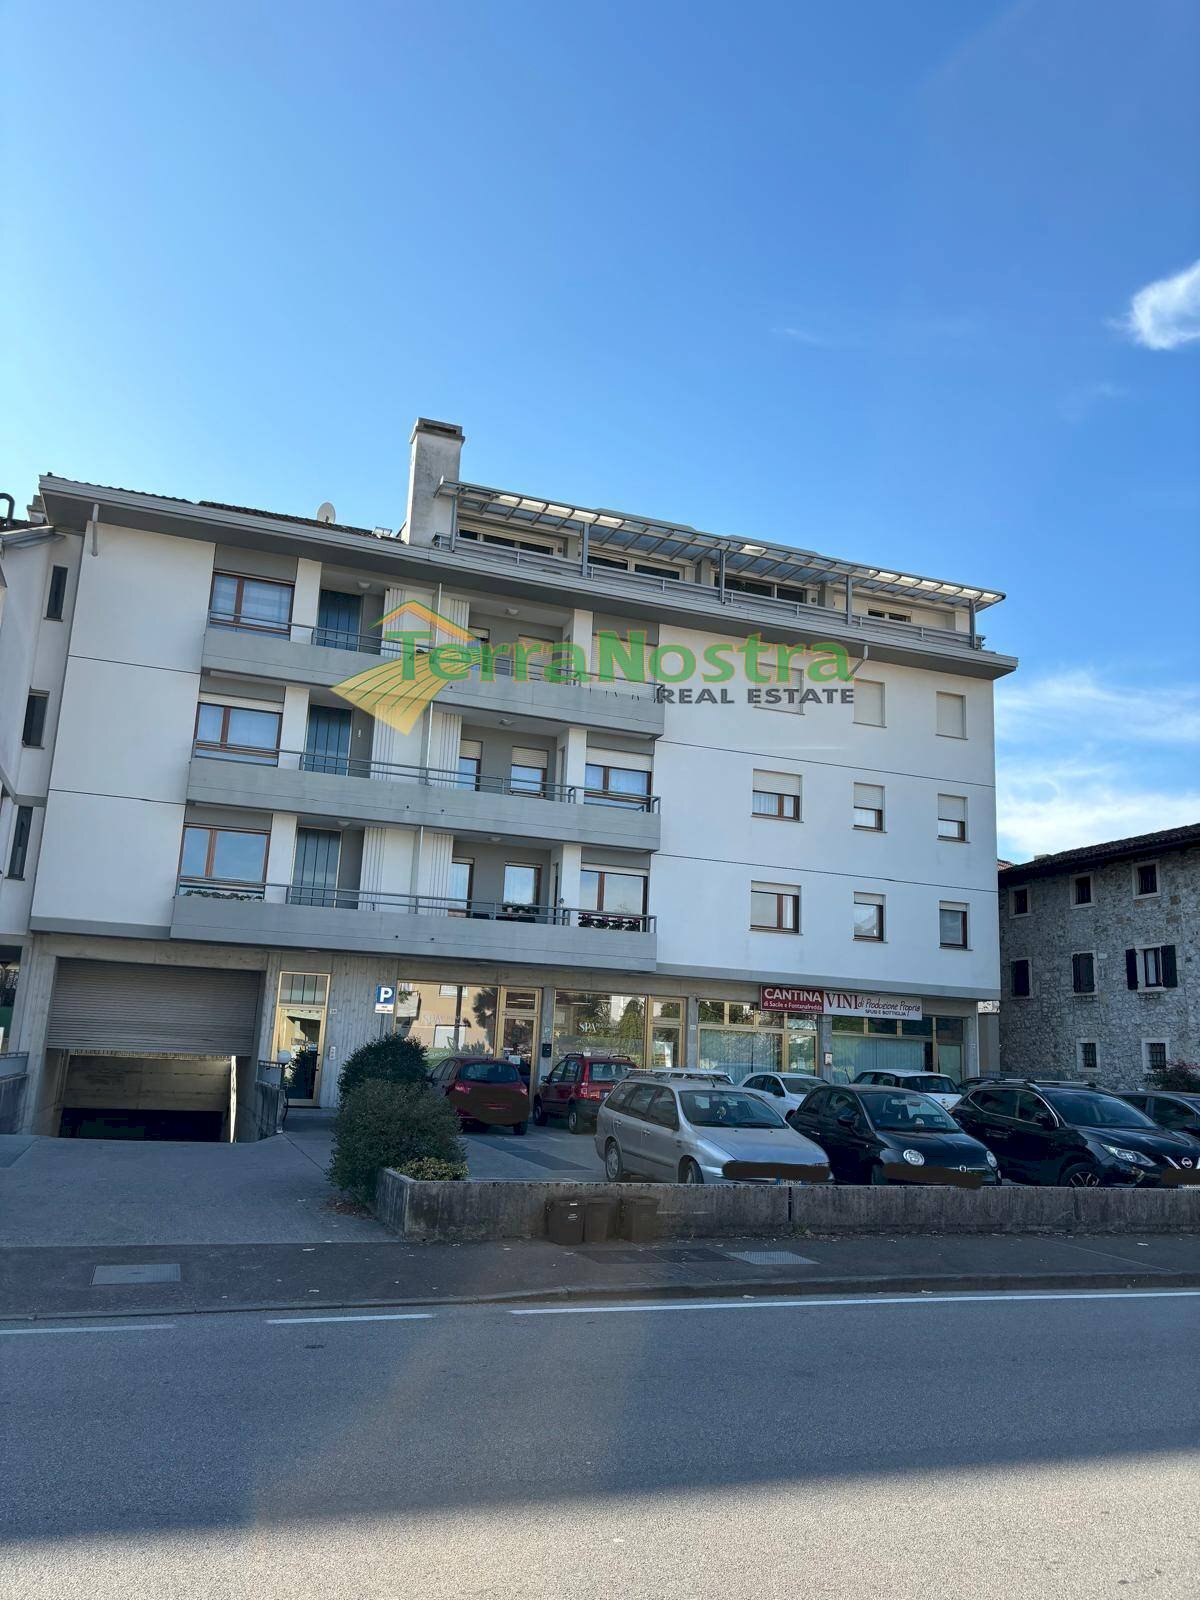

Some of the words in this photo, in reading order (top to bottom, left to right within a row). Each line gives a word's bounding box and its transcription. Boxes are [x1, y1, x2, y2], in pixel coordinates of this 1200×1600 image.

[379, 987, 393, 1002] P
[764, 988, 822, 1002] CANTINA
[825, 992, 859, 1010] VINI
[769, 1000, 784, 1008] Sacile
[578, 1022, 597, 1033] SPA
